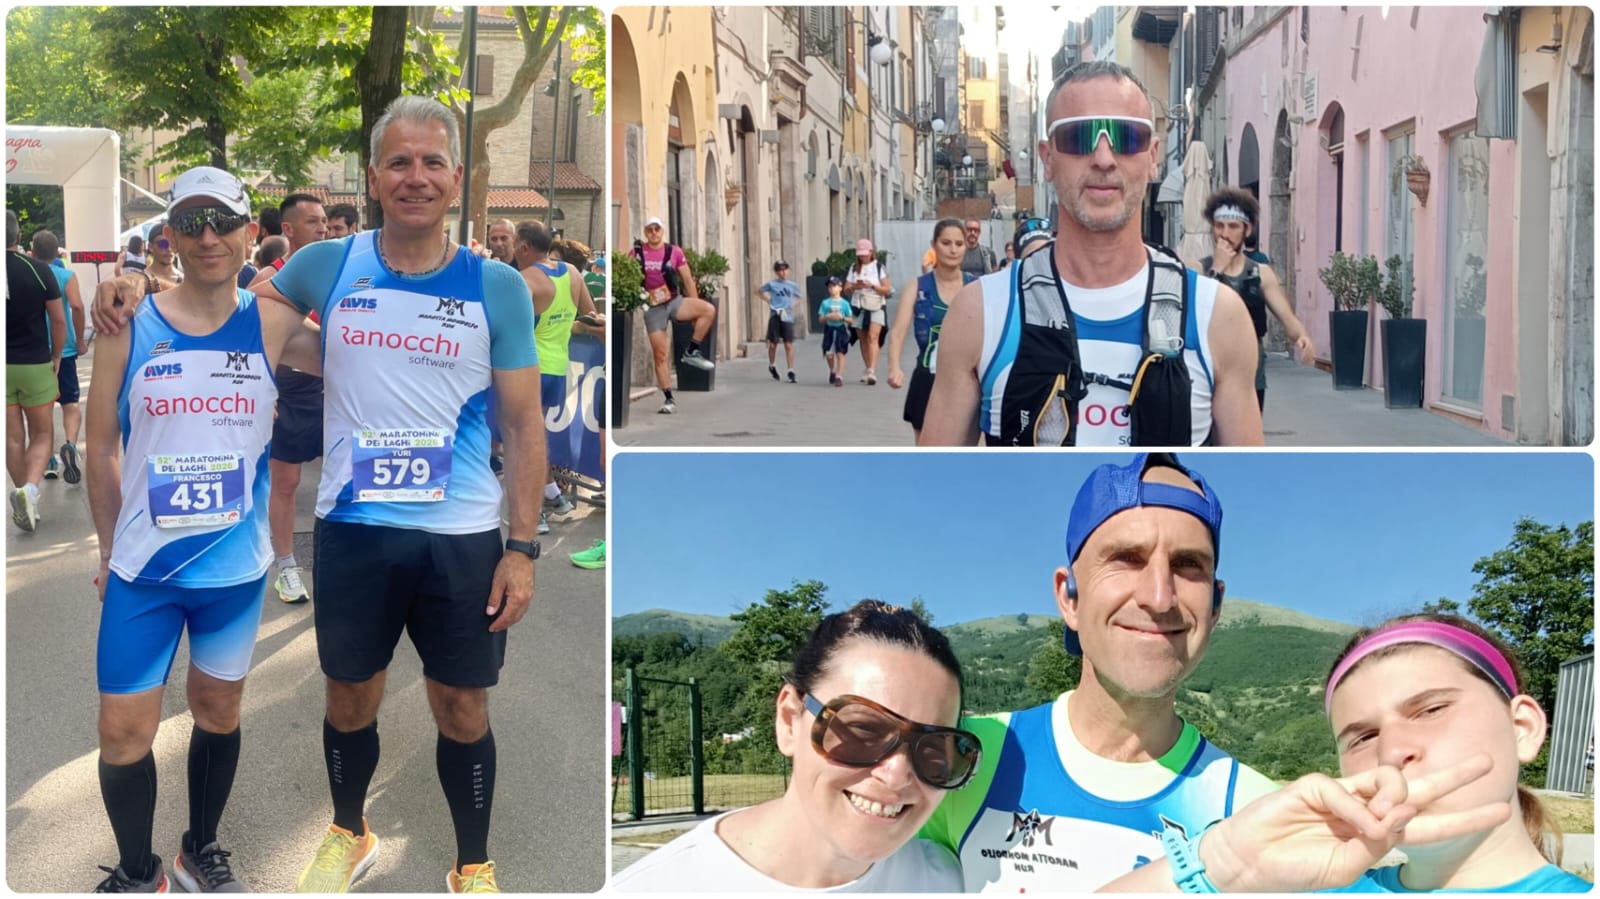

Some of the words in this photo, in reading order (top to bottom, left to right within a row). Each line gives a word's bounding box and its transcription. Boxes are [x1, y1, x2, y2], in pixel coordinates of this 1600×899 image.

[340, 297, 378, 309] AVIS
[341, 326, 460, 358] Ranocchi
[408, 355, 456, 370] software
[144, 363, 183, 378] AVIS
[144, 392, 255, 416] Ranocchi
[211, 416, 254, 428] software
[173, 473, 222, 482] FRANCESCO
[373, 458, 431, 486] 579
[169, 481, 224, 511] 431
